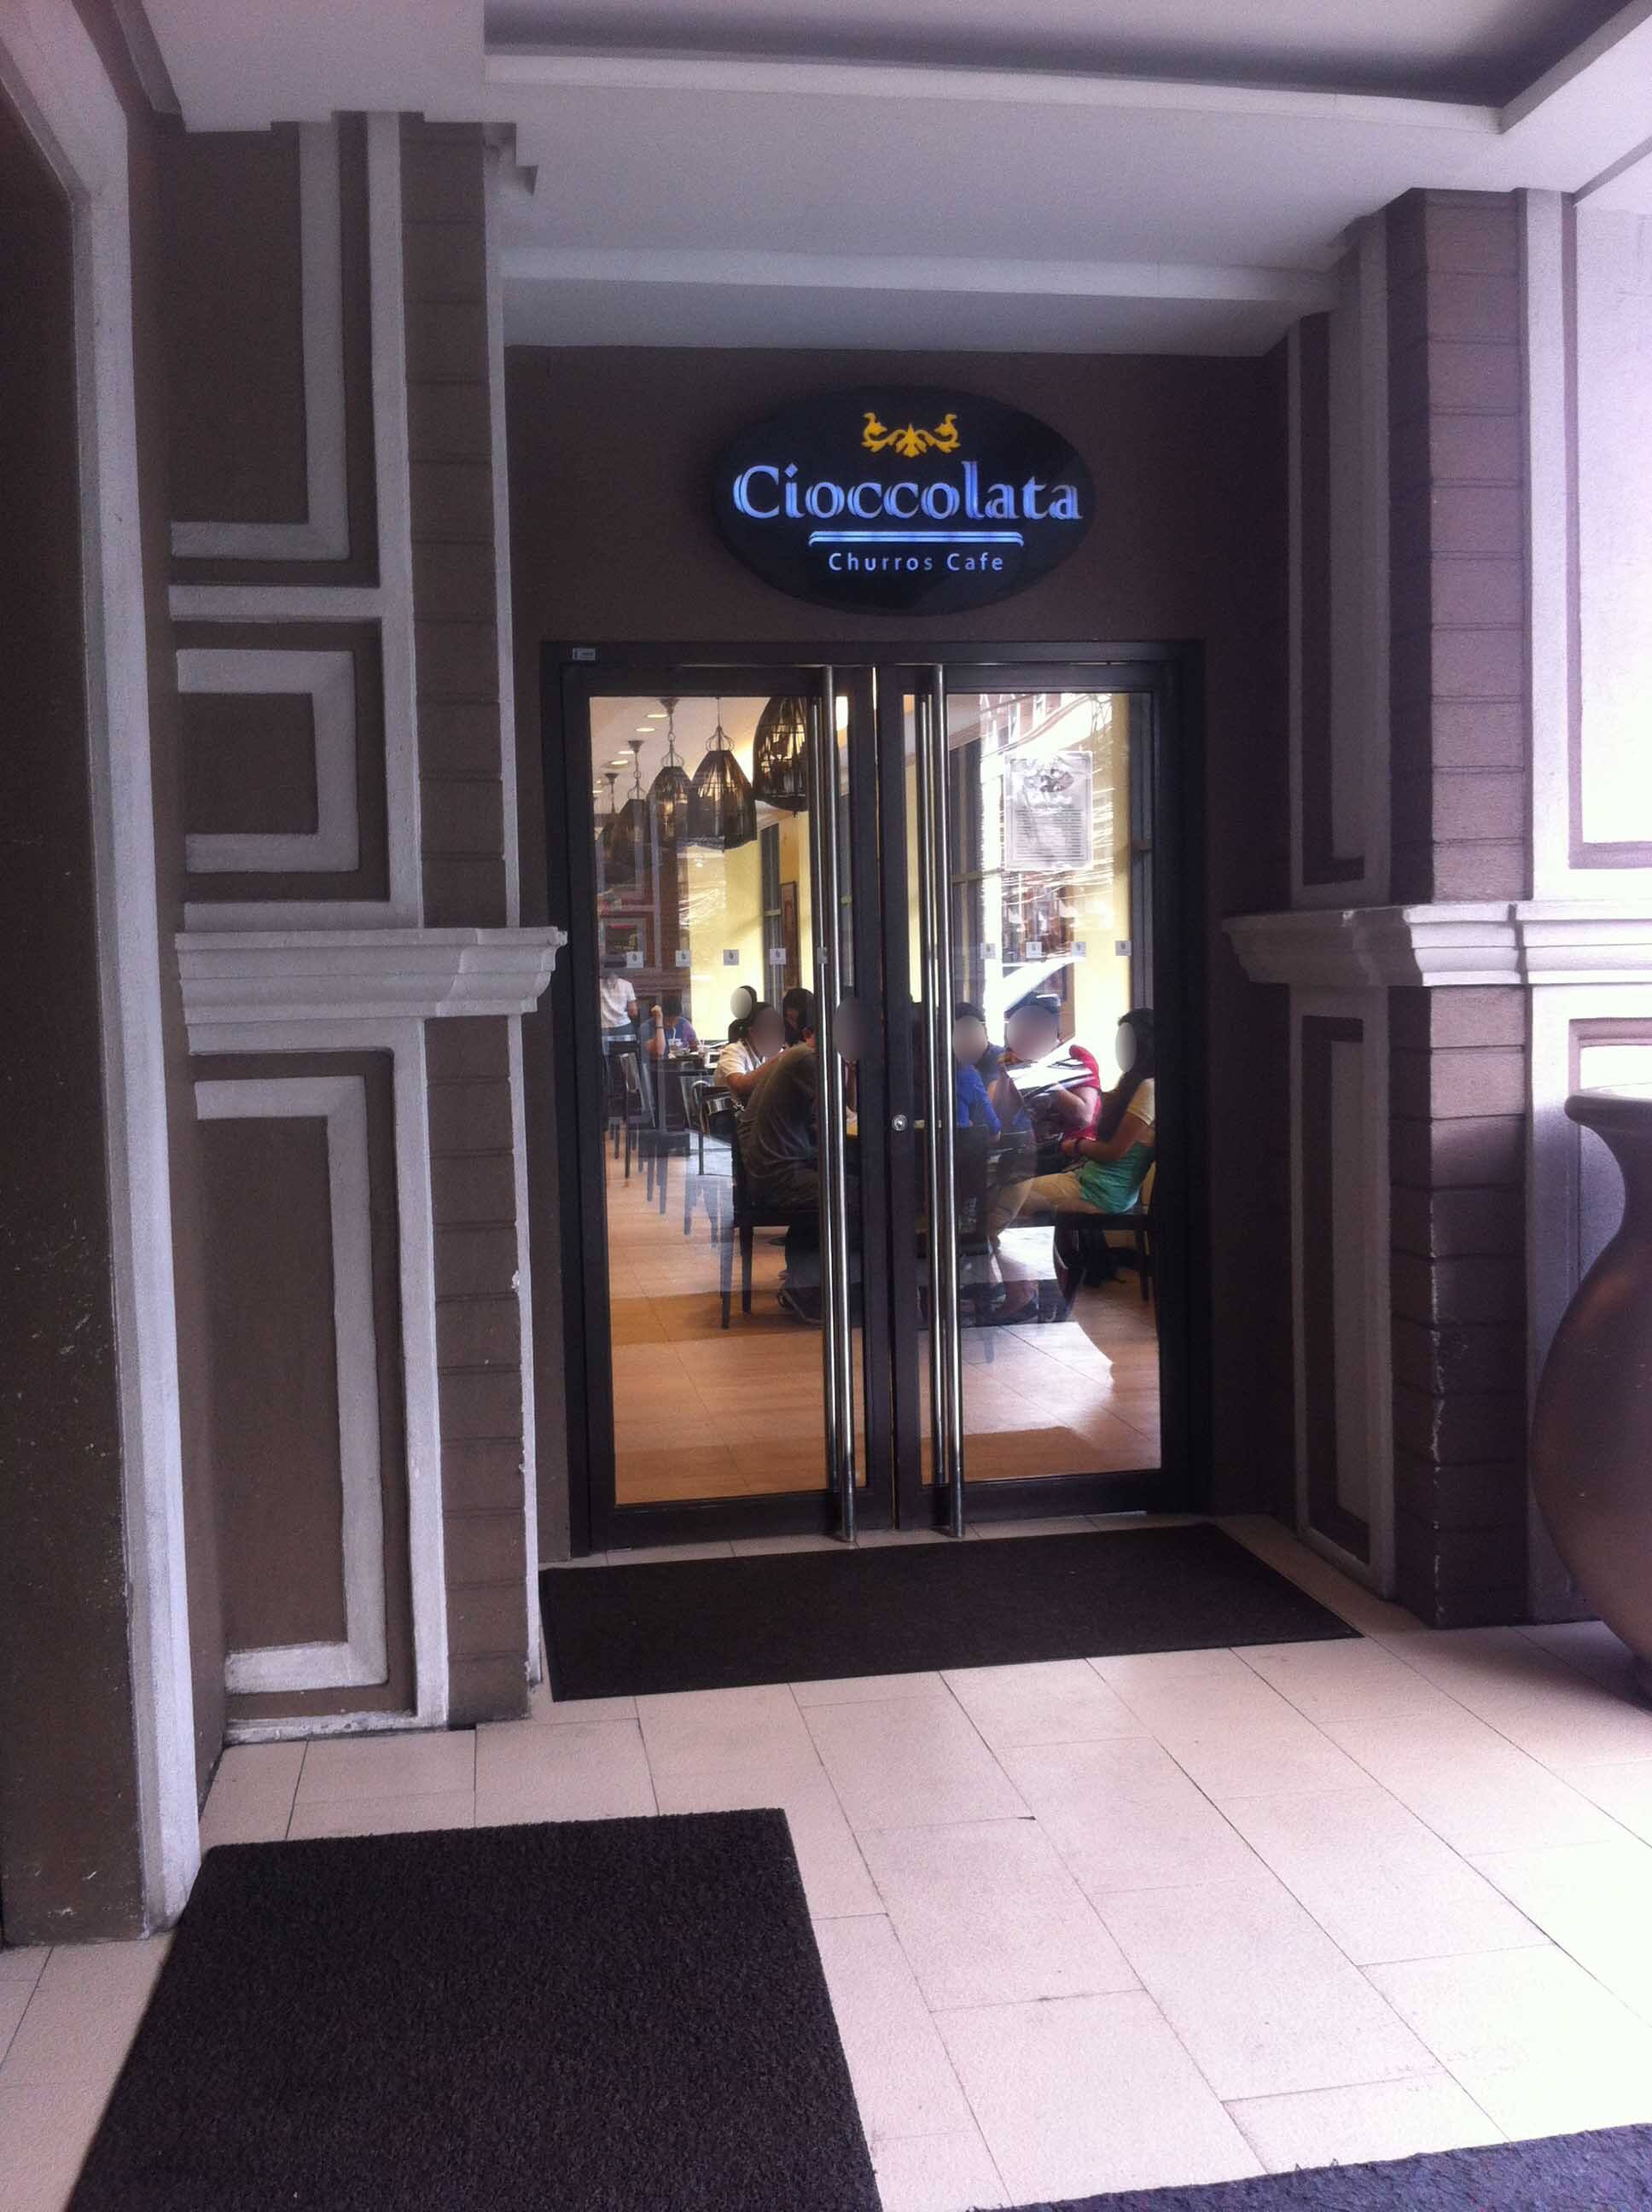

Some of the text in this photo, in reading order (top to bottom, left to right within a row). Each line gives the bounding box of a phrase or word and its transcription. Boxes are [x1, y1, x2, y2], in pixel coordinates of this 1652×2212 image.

[733, 461, 1081, 520] Cioccolata
[829, 552, 1003, 571] Churros Cafe
